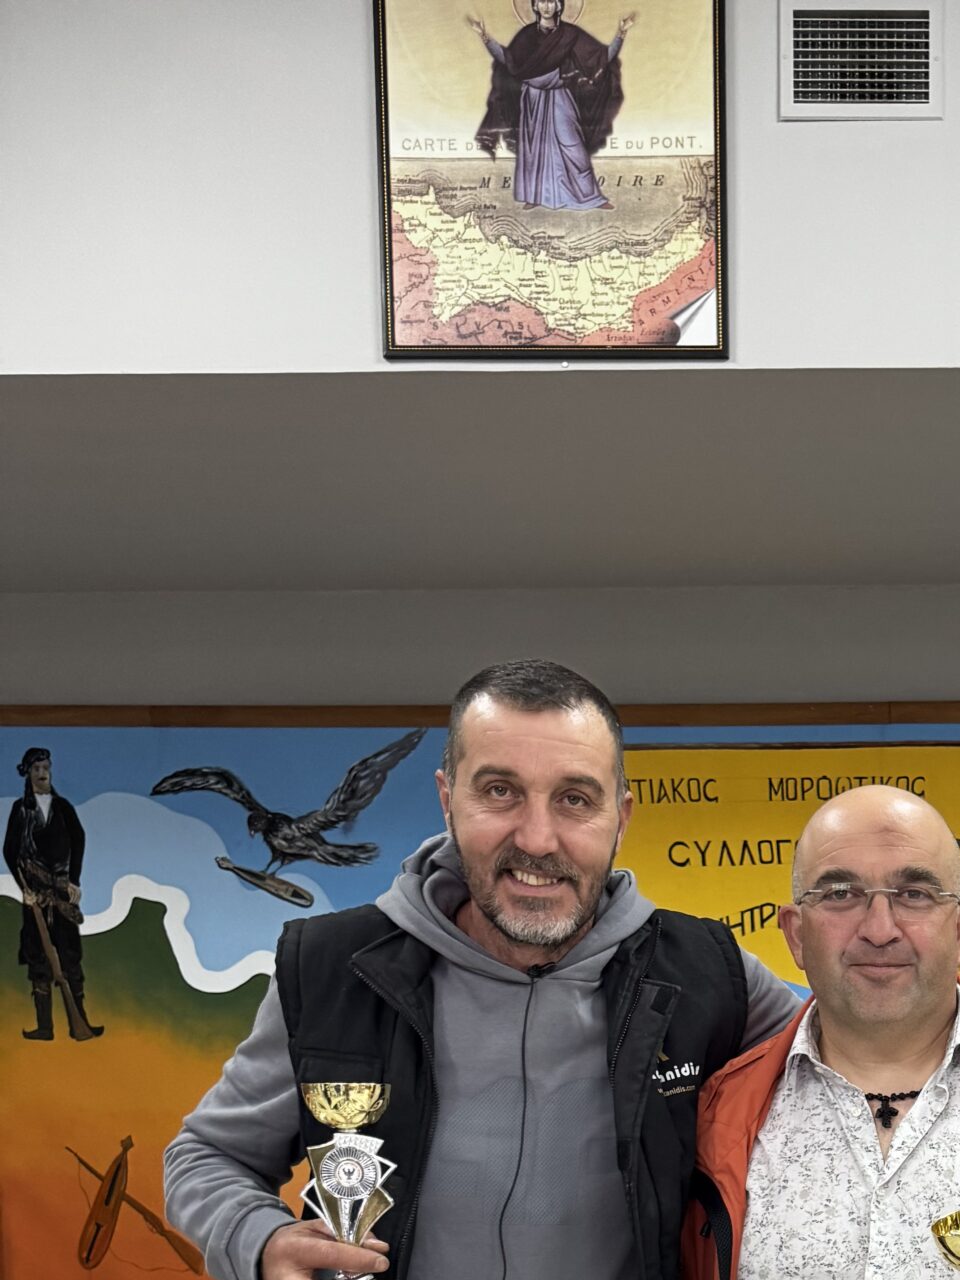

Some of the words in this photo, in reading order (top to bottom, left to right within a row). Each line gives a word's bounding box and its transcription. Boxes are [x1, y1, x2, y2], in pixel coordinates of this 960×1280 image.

[401, 138, 458, 151] CARTE
[626, 140, 644, 150] DU
[650, 135, 703, 149] PONT.
[597, 174, 665, 187] OIRE
[720, 902, 782, 936] ΗΤΡ
